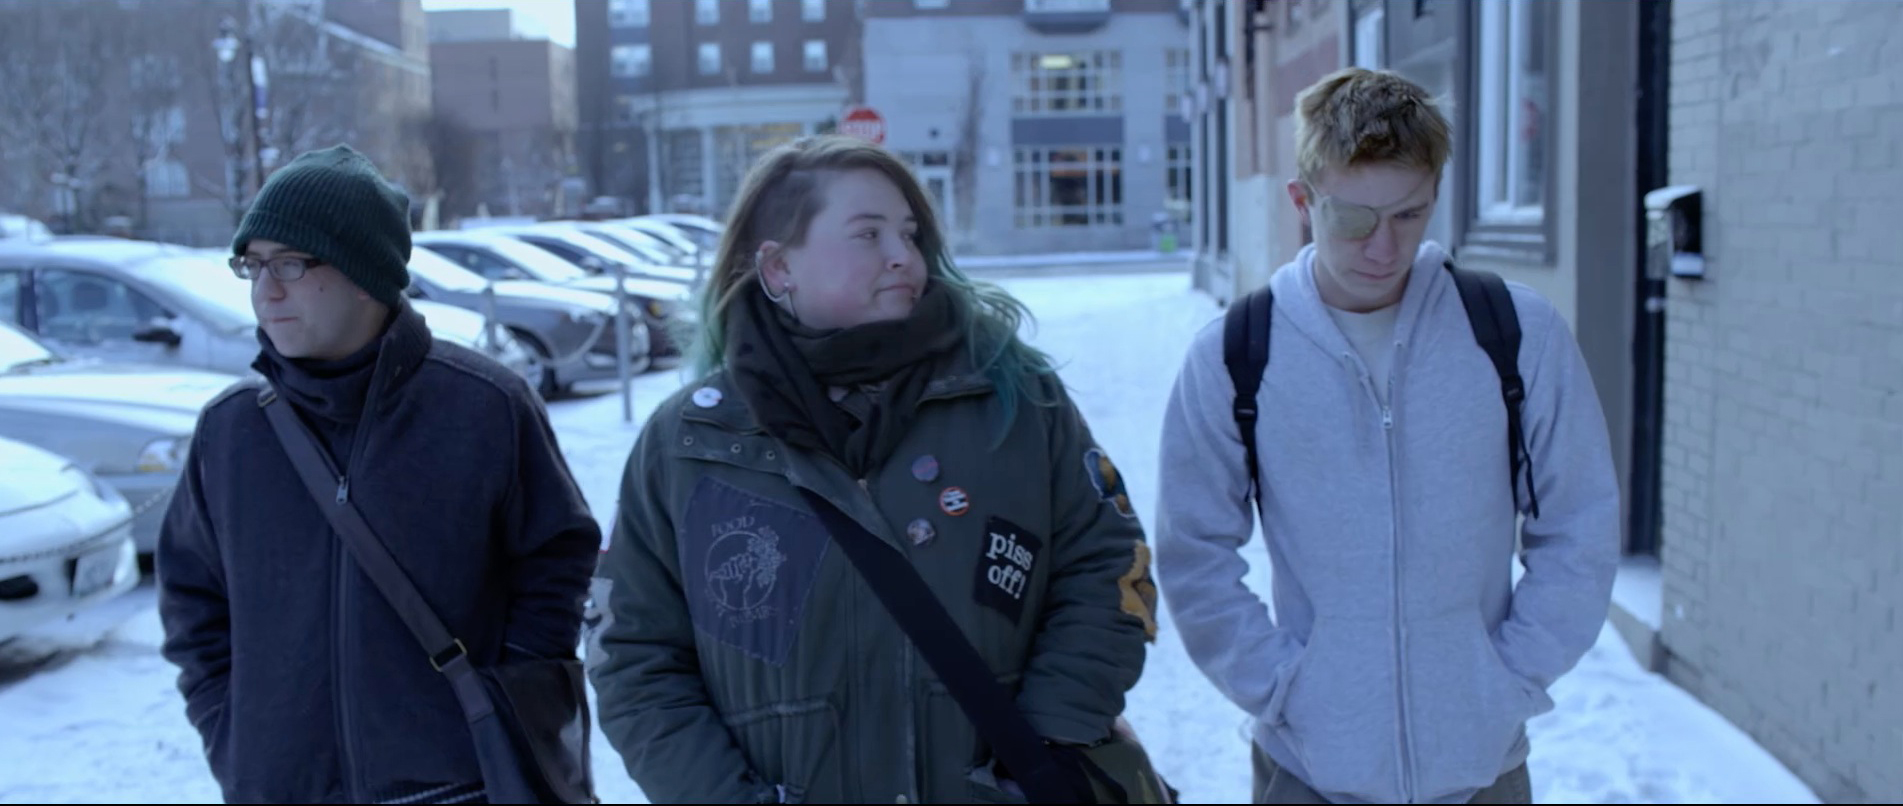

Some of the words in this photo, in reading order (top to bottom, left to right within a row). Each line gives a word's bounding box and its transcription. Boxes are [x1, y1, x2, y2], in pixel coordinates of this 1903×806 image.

[711, 516, 756, 537] FOOD
[985, 532, 1034, 571] piss
[987, 564, 1027, 600] off!
